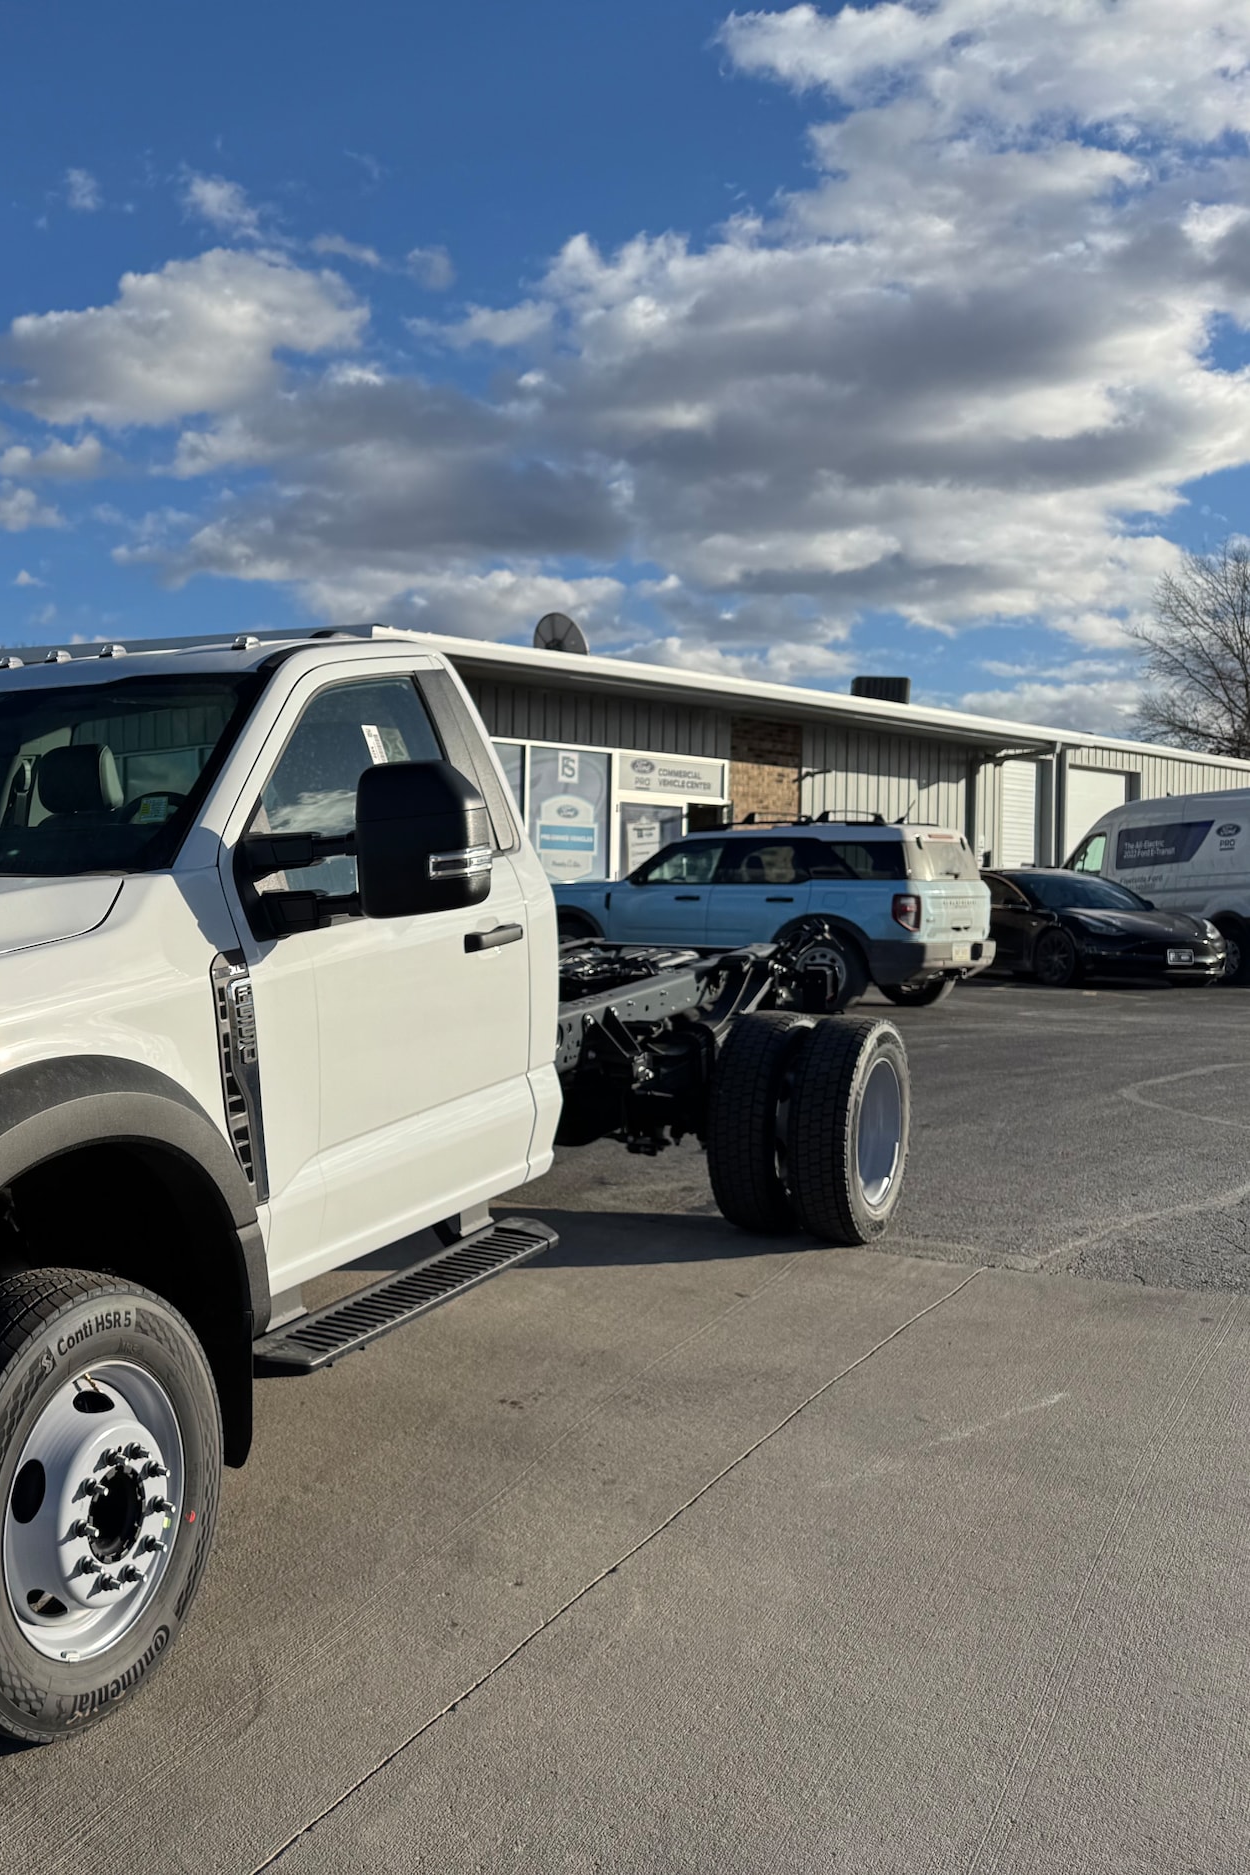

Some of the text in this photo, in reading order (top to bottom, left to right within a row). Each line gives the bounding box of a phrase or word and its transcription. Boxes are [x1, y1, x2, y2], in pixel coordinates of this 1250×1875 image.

[658, 768, 701, 780] COMMERCIAL
[635, 777, 650, 786] PRO
[658, 779, 711, 790] VEHICLE CENTER
[1219, 839, 1235, 847] PRO
[56, 1318, 92, 1356] Conti
[95, 1311, 121, 1333] HSR
[124, 1310, 132, 1328] 5
[68, 1624, 171, 1720] Continental
